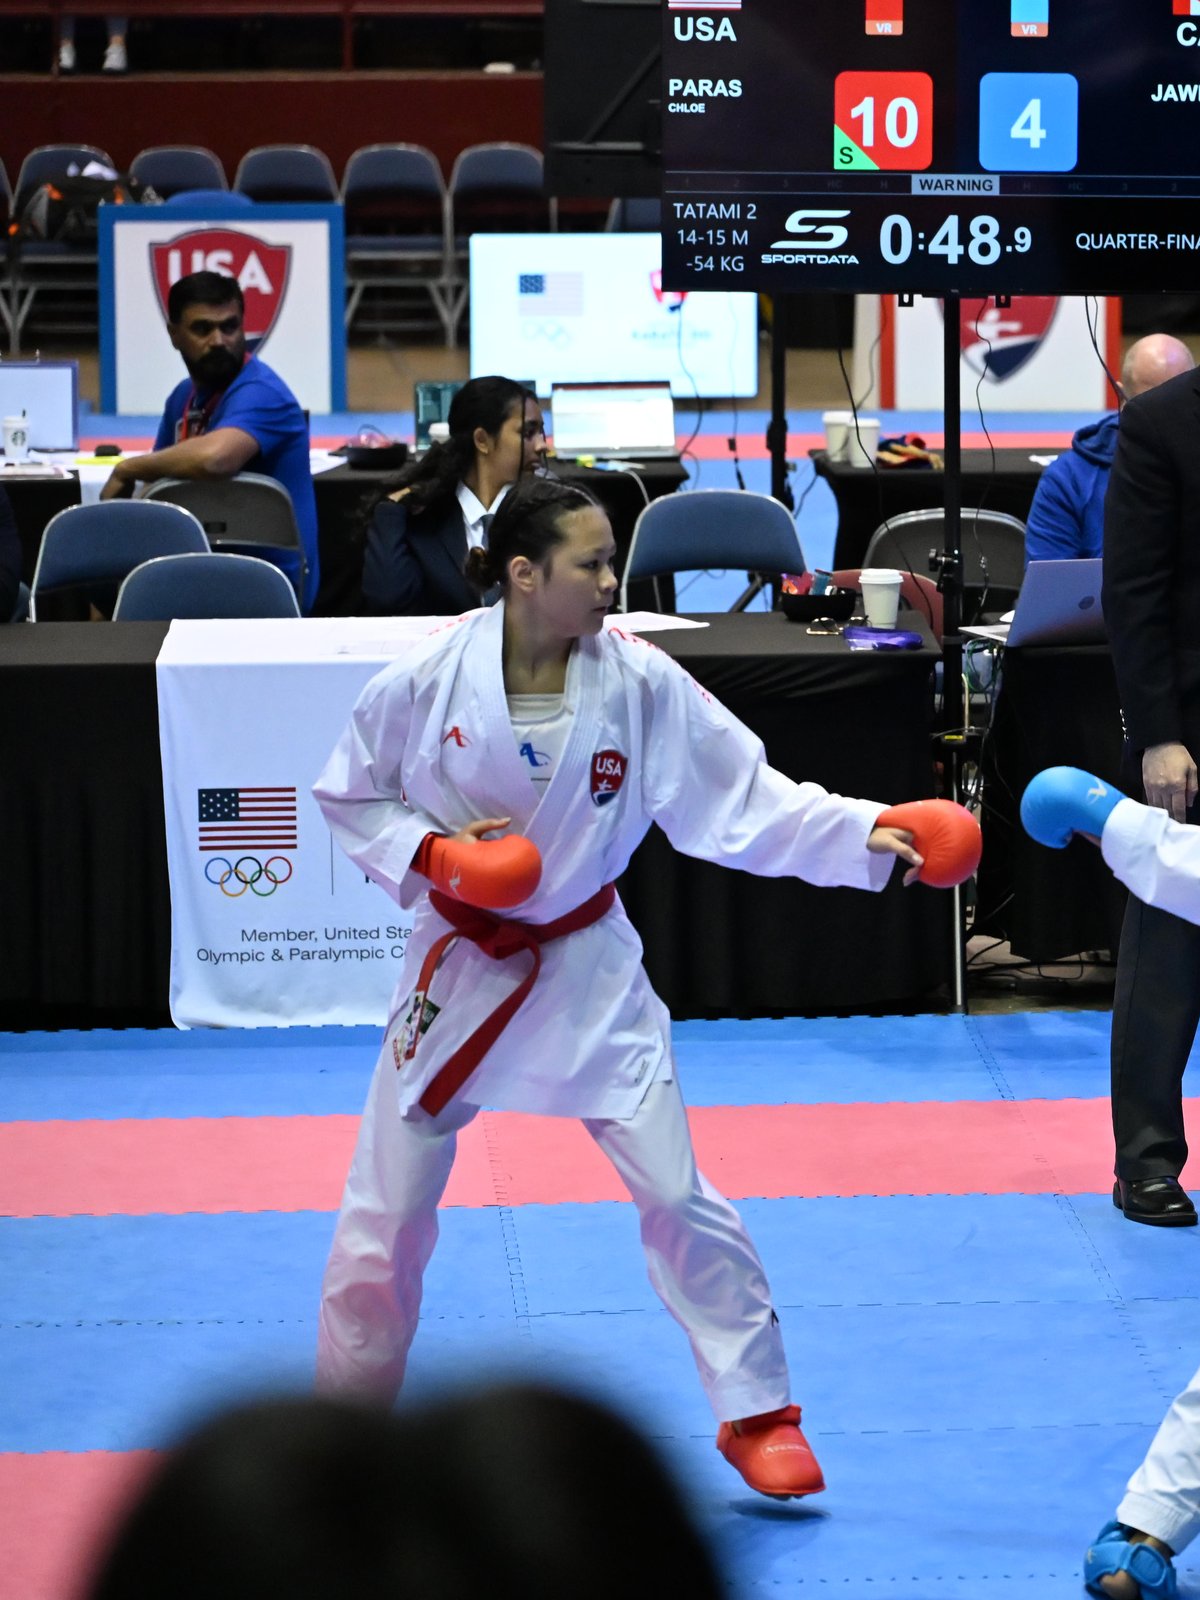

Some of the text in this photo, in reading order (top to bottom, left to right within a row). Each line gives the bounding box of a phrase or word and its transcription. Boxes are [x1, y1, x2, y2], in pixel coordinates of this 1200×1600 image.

[673, 17, 737, 42] USA
[876, 23, 892, 33] VR
[1021, 25, 1037, 34] VR
[668, 79, 742, 97] PARAS
[668, 103, 705, 113] CHLOE
[850, 96, 919, 148] 10
[1010, 98, 1046, 149] 4
[839, 147, 854, 165] S
[919, 178, 993, 192] WARNING
[673, 203, 757, 219] TATAMI 2
[677, 230, 749, 245] 14-15 M
[686, 256, 745, 272] -54 KG
[761, 254, 859, 265] SPORTDATA
[168, 248, 274, 295] USA
[596, 757, 622, 776] USA
[241, 926, 412, 943] Member, United Sta
[197, 946, 265, 966] Olympic
[271, 948, 284, 961] &
[289, 945, 385, 965] Paralympic
